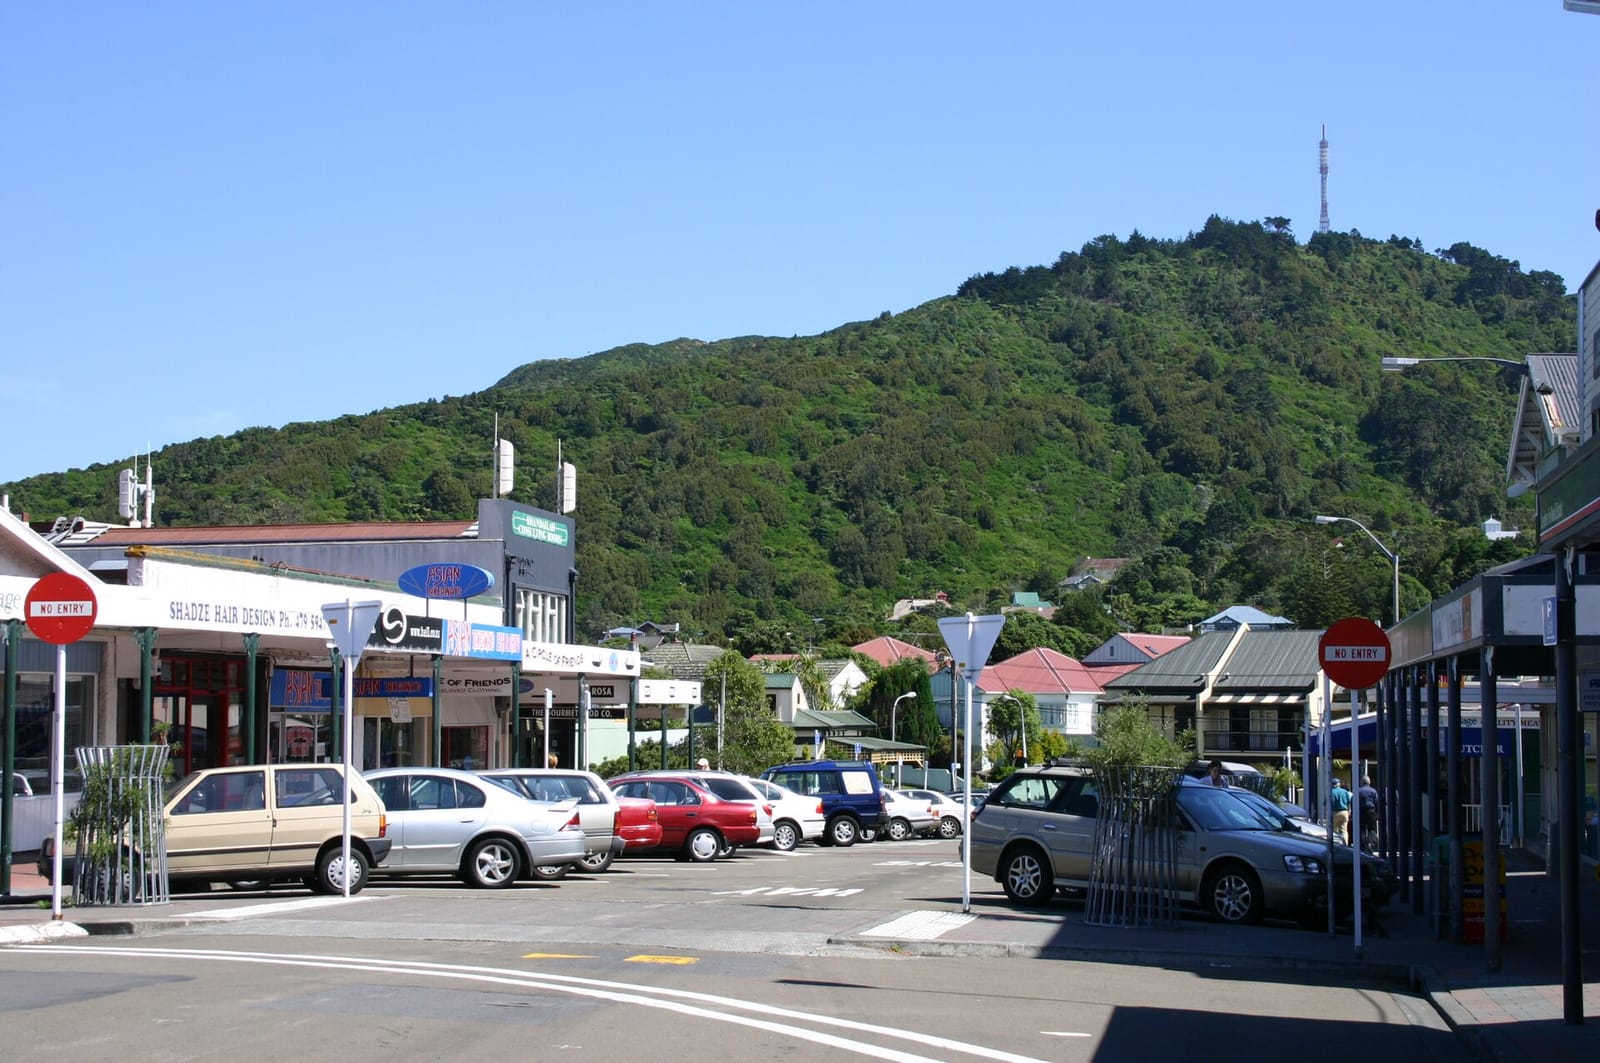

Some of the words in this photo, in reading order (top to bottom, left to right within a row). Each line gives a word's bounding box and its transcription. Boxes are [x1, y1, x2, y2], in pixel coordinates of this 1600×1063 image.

[426, 566, 462, 585] ASIAN
[40, 603, 53, 614] NO
[57, 603, 84, 614] ENTRY
[169, 601, 210, 622] SHADZE
[214, 604, 238, 624] HAIR
[242, 607, 275, 627] DESIGN
[1334, 648, 1348, 659] NO
[1351, 648, 1378, 659] ENTRY
[447, 679, 462, 687] OF
[465, 677, 511, 687] FRIENDS
[591, 687, 612, 696] ROSA
[532, 709, 544, 717] THE
[550, 709, 578, 717] OURMET
